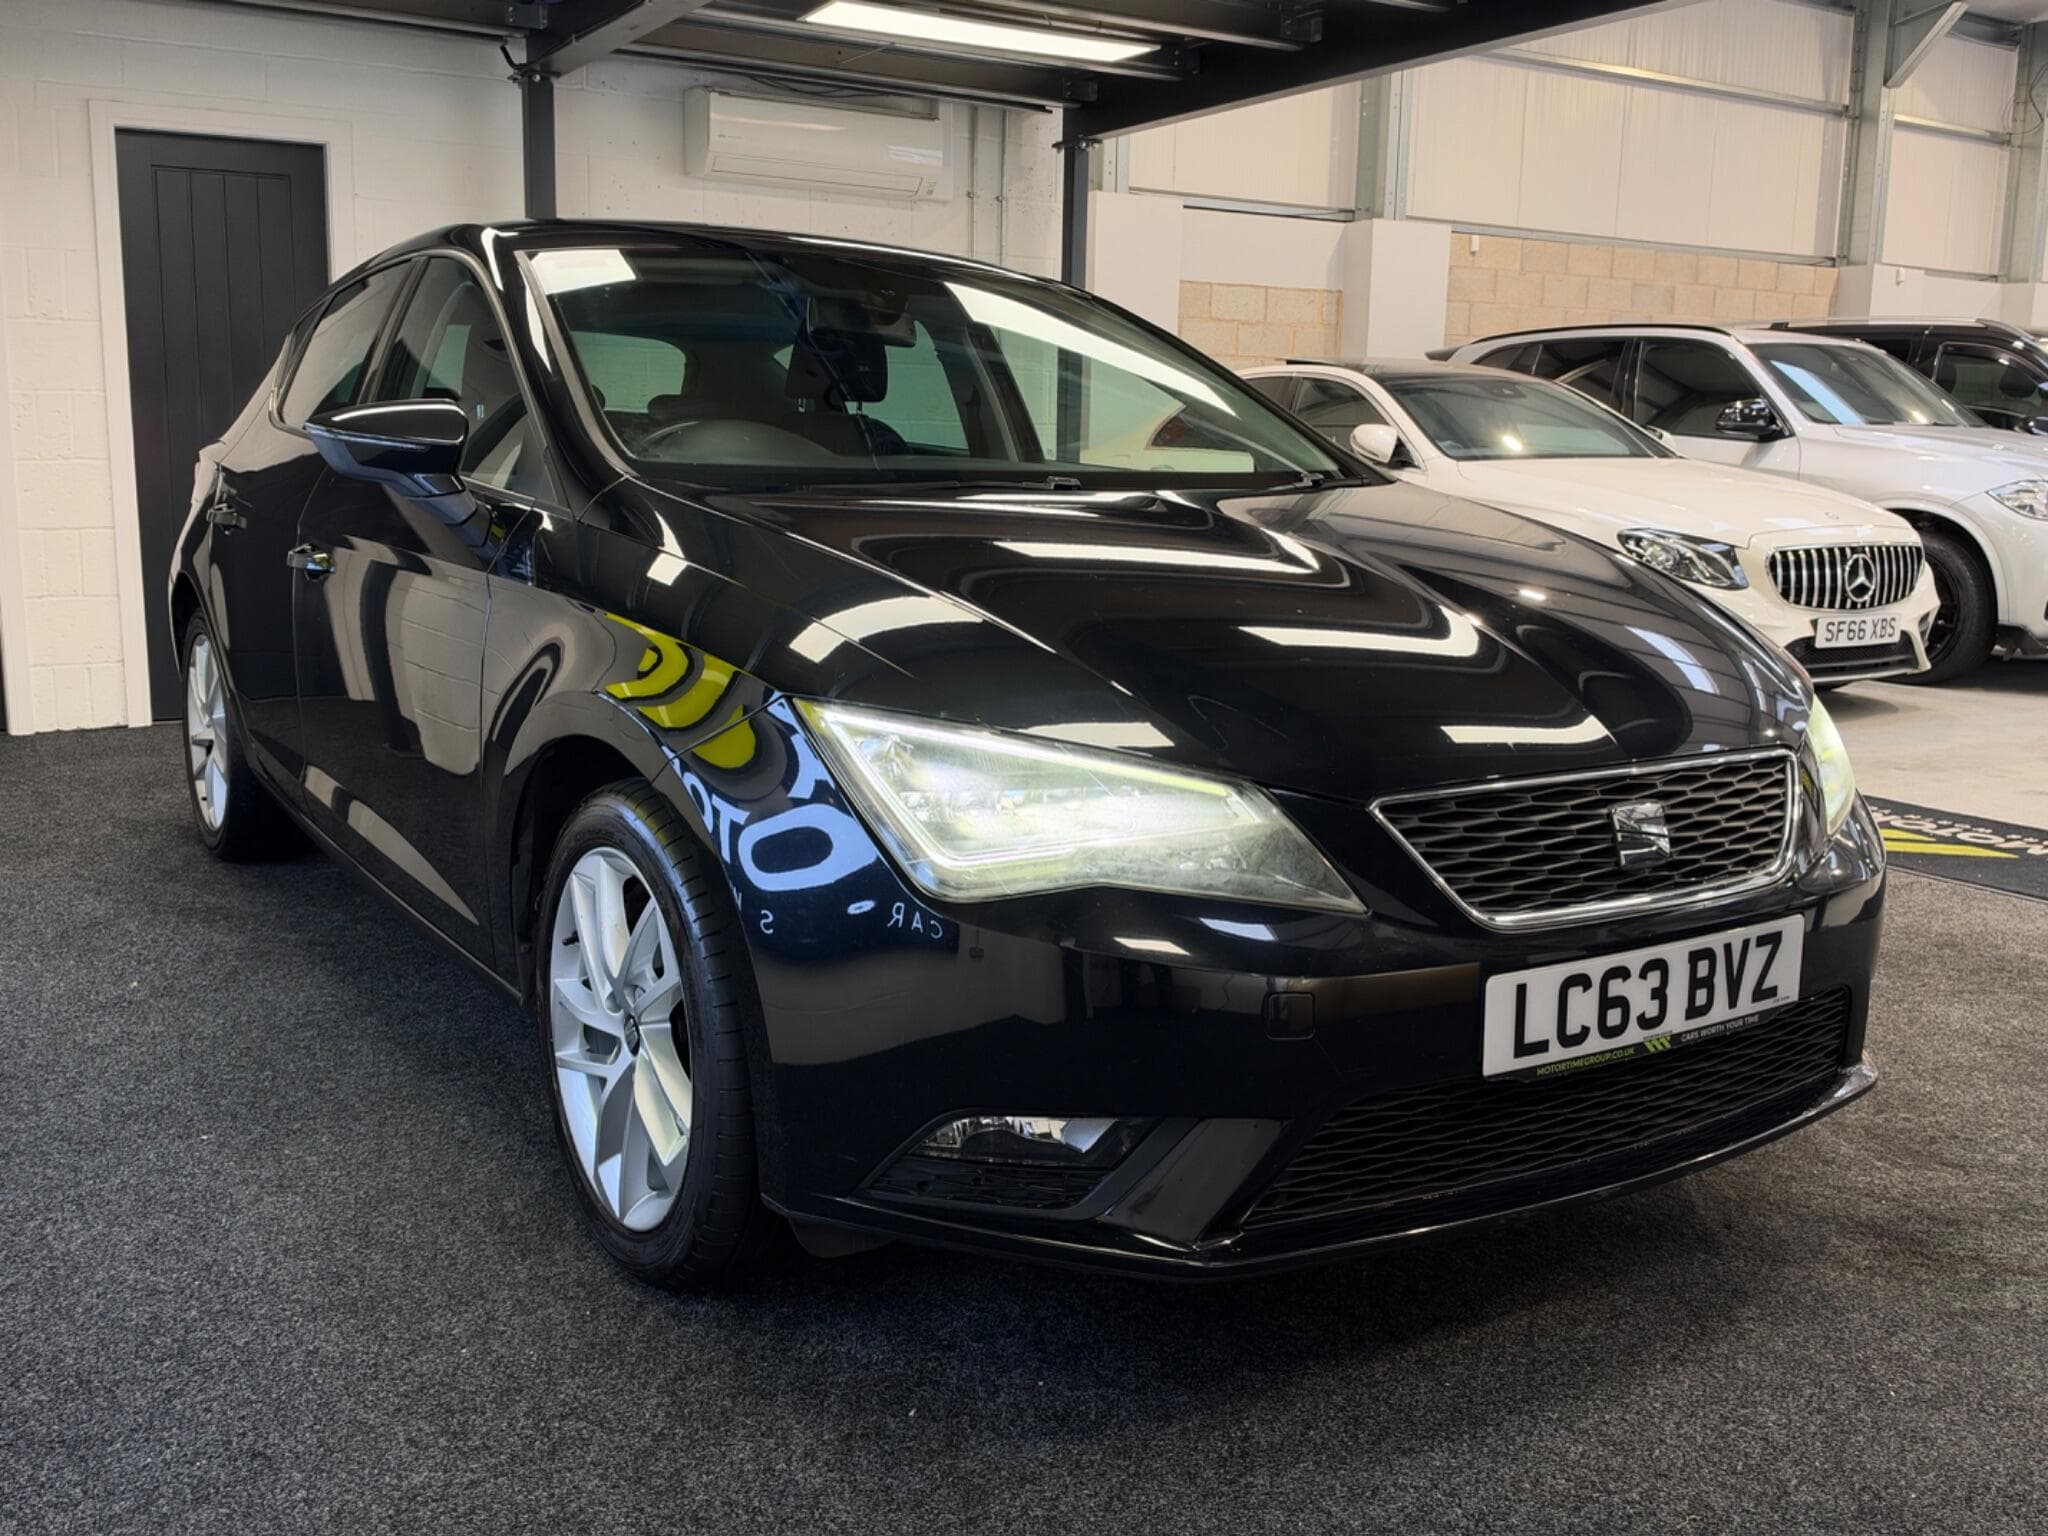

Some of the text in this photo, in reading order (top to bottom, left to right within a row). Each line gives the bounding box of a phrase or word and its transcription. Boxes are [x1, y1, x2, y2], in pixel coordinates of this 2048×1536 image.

[1824, 617, 1897, 642] SF66 XBS
[1513, 930, 1784, 1060] LC63 BVZ
[1681, 1032, 1699, 1042] CARS
[1700, 1024, 1724, 1037] WORTH
[1726, 1019, 1743, 1030] YOUR
[1745, 1014, 1760, 1024] TIME
[1536, 1047, 1636, 1077] MOTORTIMEGROUP.CO.UK
